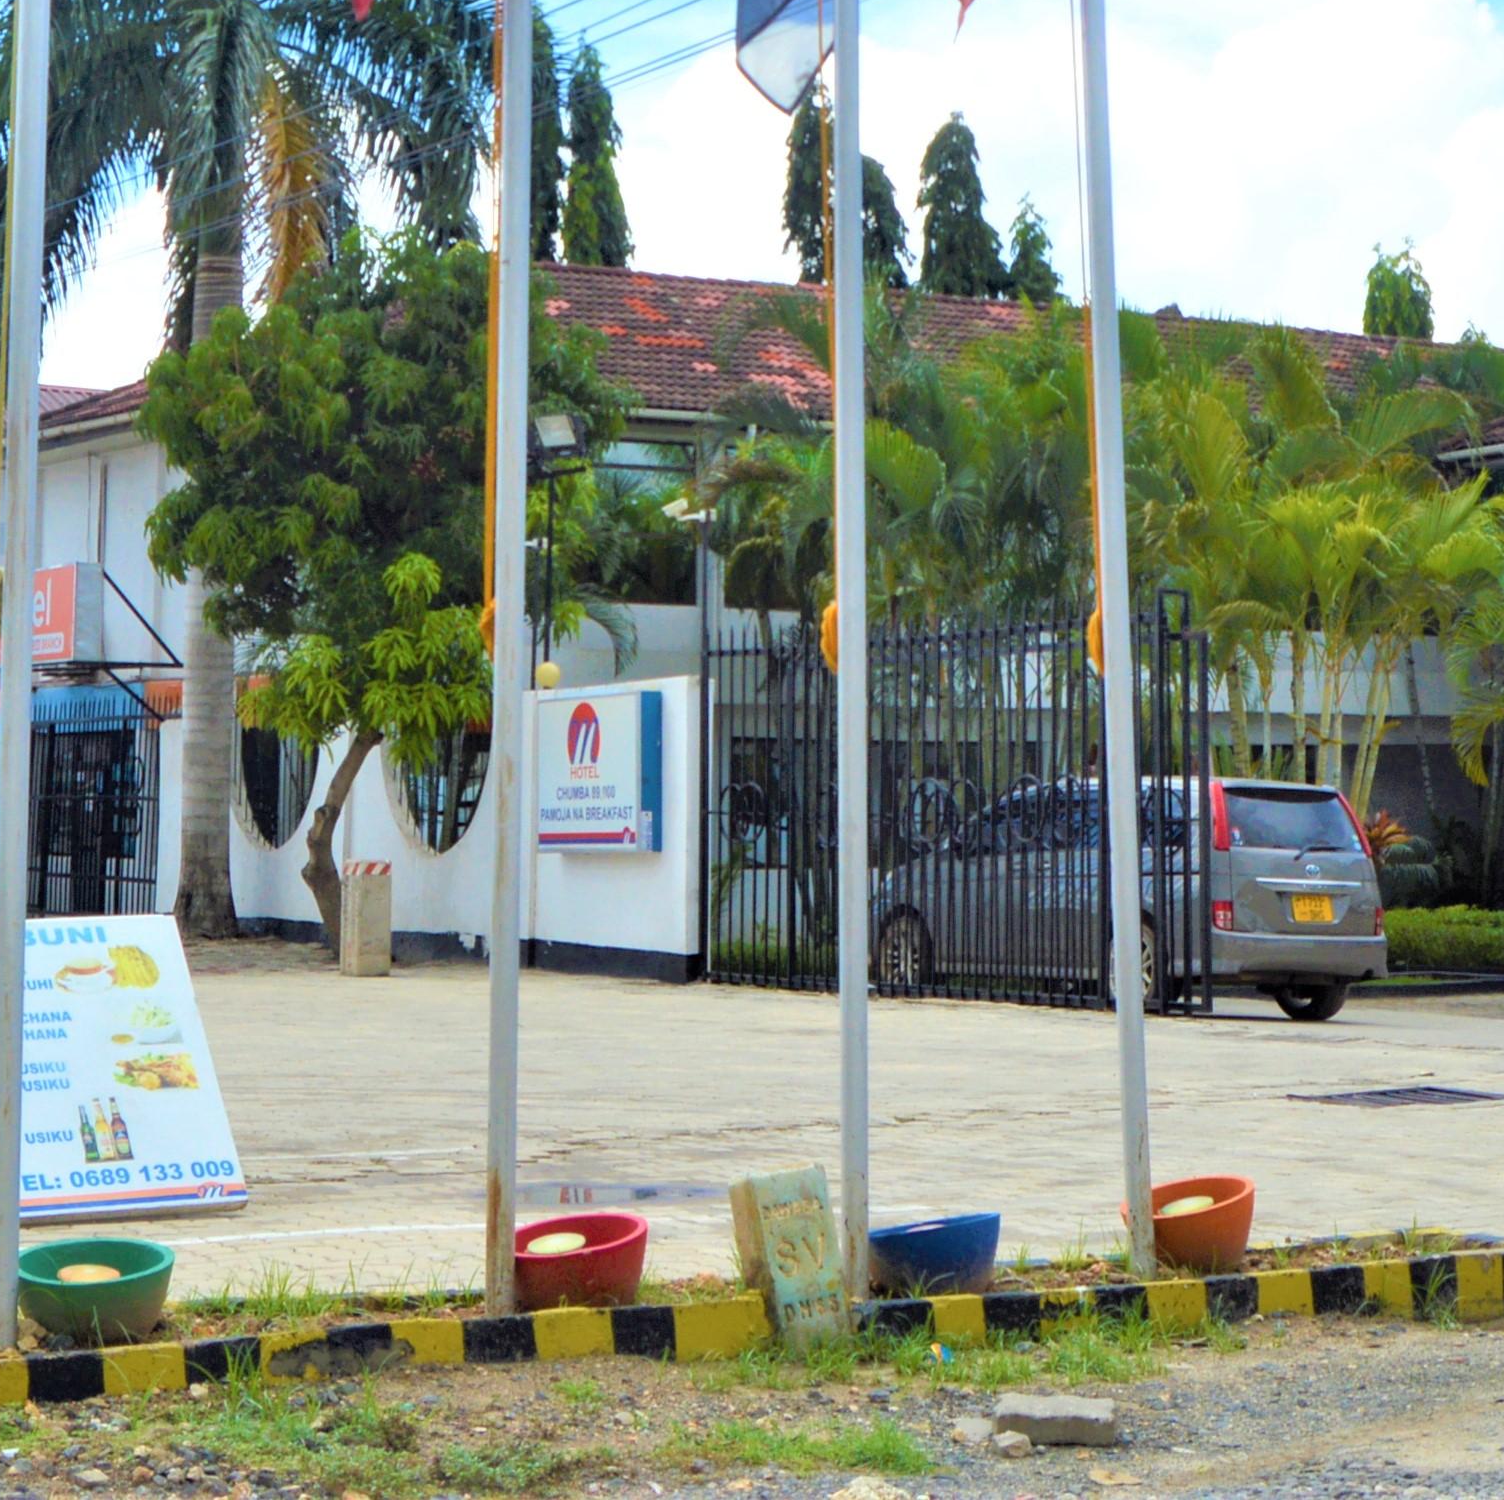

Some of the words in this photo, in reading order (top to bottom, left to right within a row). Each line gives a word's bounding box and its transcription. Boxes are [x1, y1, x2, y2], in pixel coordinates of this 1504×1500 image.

[570, 766, 599, 779] HOTEL
[557, 786, 589, 800] CHUMBA
[541, 807, 571, 821] PAMOJA
[572, 807, 583, 820] NA
[585, 806, 633, 820] BREAKFAST
[22, 1078, 70, 1092] USIKU
[25, 1130, 73, 1145] USIKU
[22, 1174, 62, 1191] EL:
[70, 1167, 130, 1188] 0689
[139, 1163, 183, 1182] 133
[191, 1160, 234, 1178] 009
